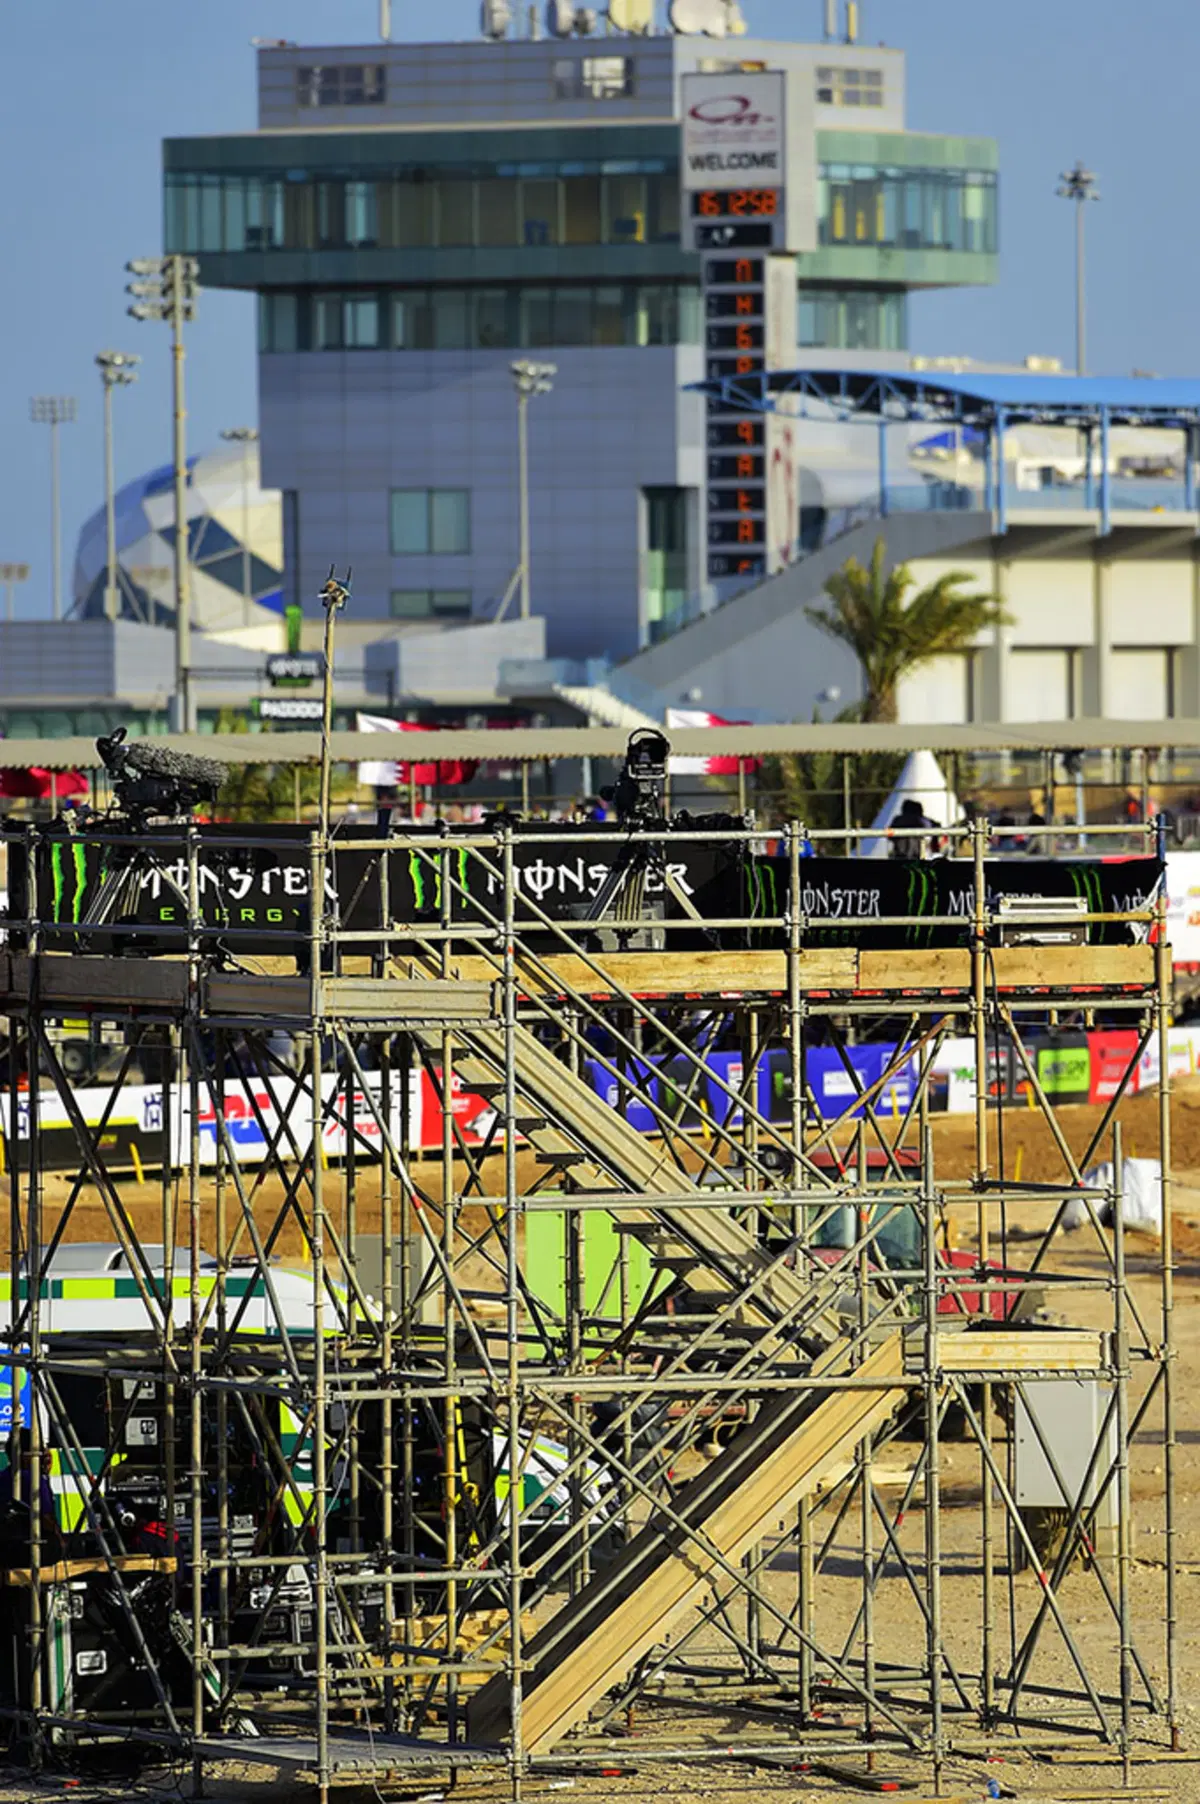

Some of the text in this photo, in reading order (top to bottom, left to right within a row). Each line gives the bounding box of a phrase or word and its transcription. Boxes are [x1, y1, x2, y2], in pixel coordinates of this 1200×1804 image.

[688, 151, 778, 172] WELCOME
[140, 857, 338, 900] MONSTER
[486, 857, 695, 900] MONSER
